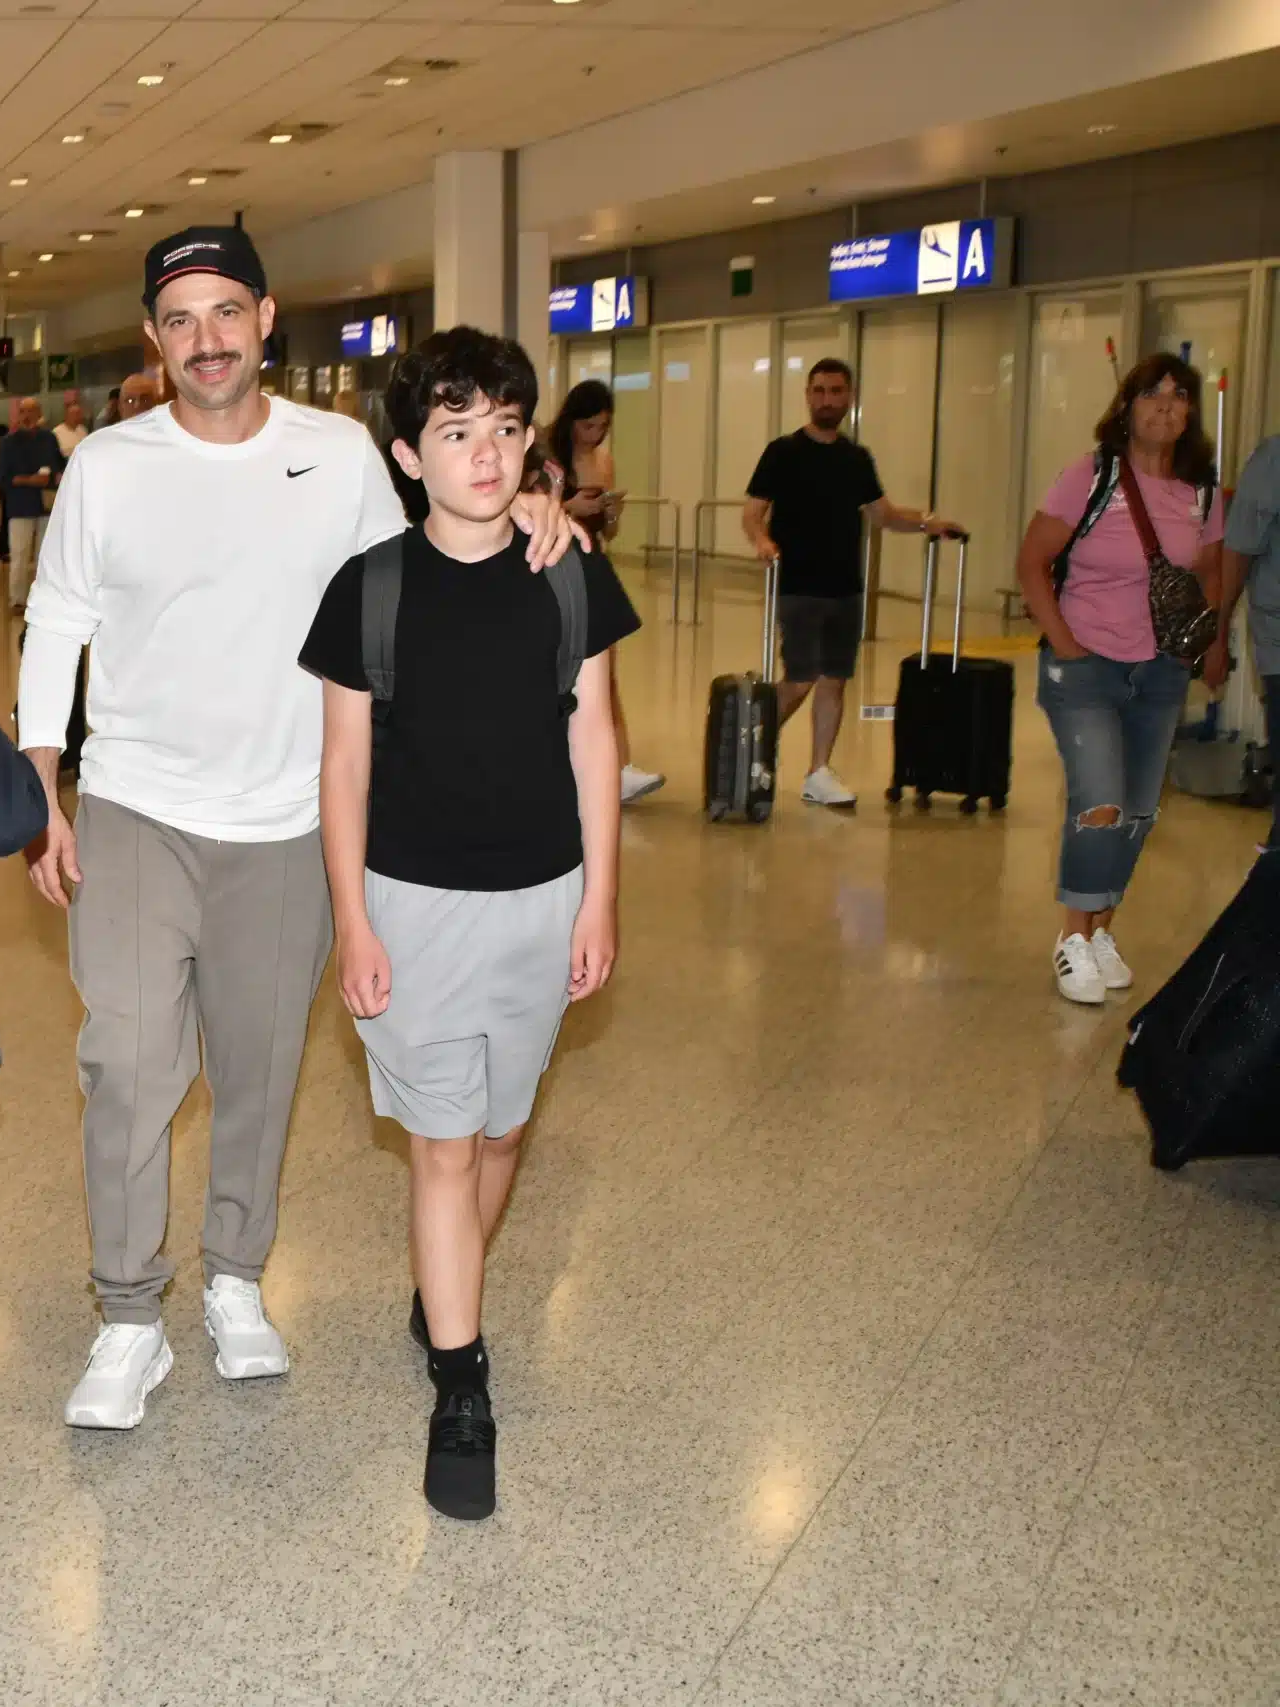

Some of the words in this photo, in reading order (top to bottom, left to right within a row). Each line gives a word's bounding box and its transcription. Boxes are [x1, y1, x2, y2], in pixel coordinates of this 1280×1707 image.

[163, 243, 220, 260] PORSCHE
[963, 228, 986, 279] A
[616, 282, 631, 321] A
